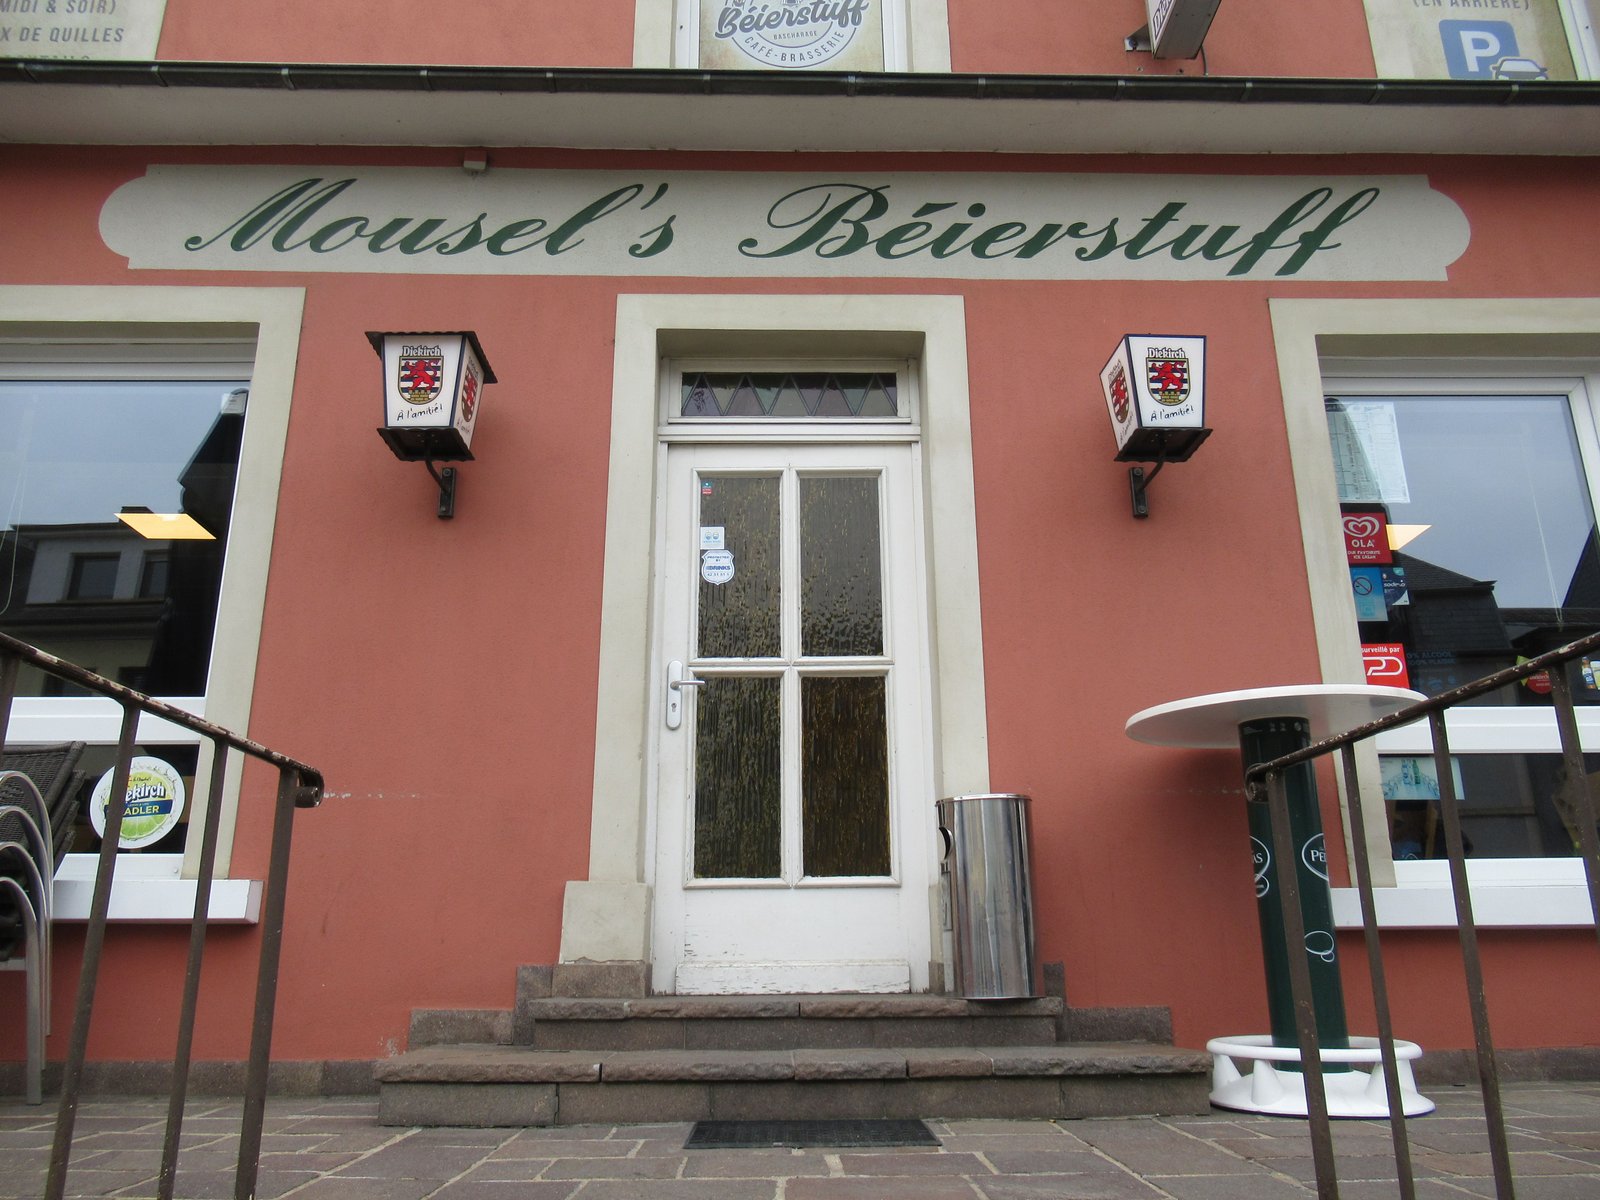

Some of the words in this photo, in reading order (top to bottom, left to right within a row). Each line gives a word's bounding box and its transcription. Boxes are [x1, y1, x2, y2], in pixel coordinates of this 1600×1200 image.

[46, 0, 56, 13] &
[714, 0, 869, 39] Béierstuff
[20, 27, 42, 41] DE
[49, 27, 124, 42] QUILLES
[773, 30, 818, 41] BASCHARAGE
[744, 31, 845, 62] CAFÉ-BRASSERIE
[1460, 31, 1500, 72] P
[184, 177, 677, 258] Mousel's
[737, 183, 1381, 277] Béierstuff
[401, 345, 442, 357] Diekirch
[1147, 347, 1186, 359] Diekirch
[1351, 539, 1375, 548] OLA
[125, 782, 166, 803] ekirch
[123, 805, 160, 816] ADLER
